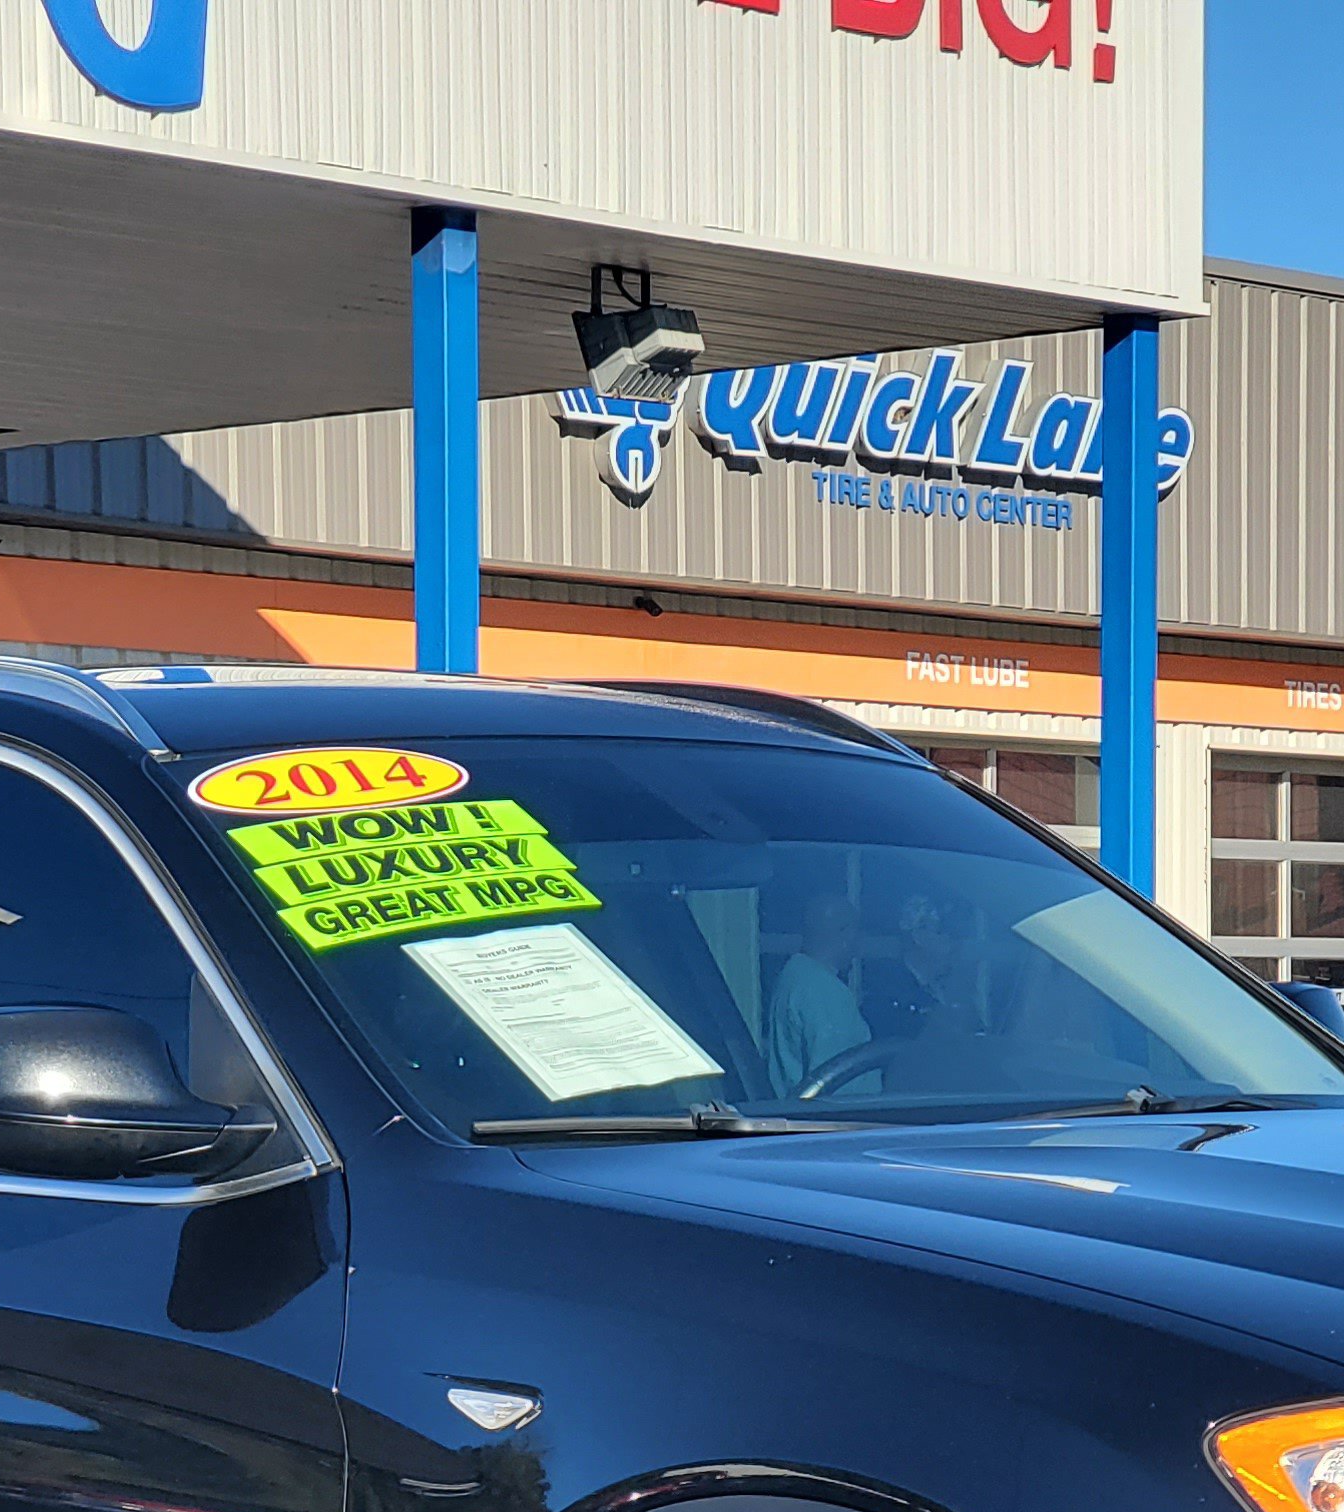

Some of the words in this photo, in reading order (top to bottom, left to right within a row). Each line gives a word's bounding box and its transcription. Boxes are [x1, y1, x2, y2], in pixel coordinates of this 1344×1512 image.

[699, 347, 986, 464] Quick
[971, 358, 1195, 490] Lae
[812, 471, 871, 508] TIRE
[878, 479, 895, 511] &
[901, 482, 969, 519] AUTO
[976, 491, 1073, 530] CENTER
[906, 651, 965, 684] FAST
[970, 656, 1030, 688] LUBE
[1285, 681, 1342, 711] TIRES
[235, 755, 428, 806] 2014
[269, 805, 460, 851] WOW
[282, 837, 534, 896] LUXURY
[304, 885, 466, 937] GREAT
[464, 873, 585, 909] MPG
